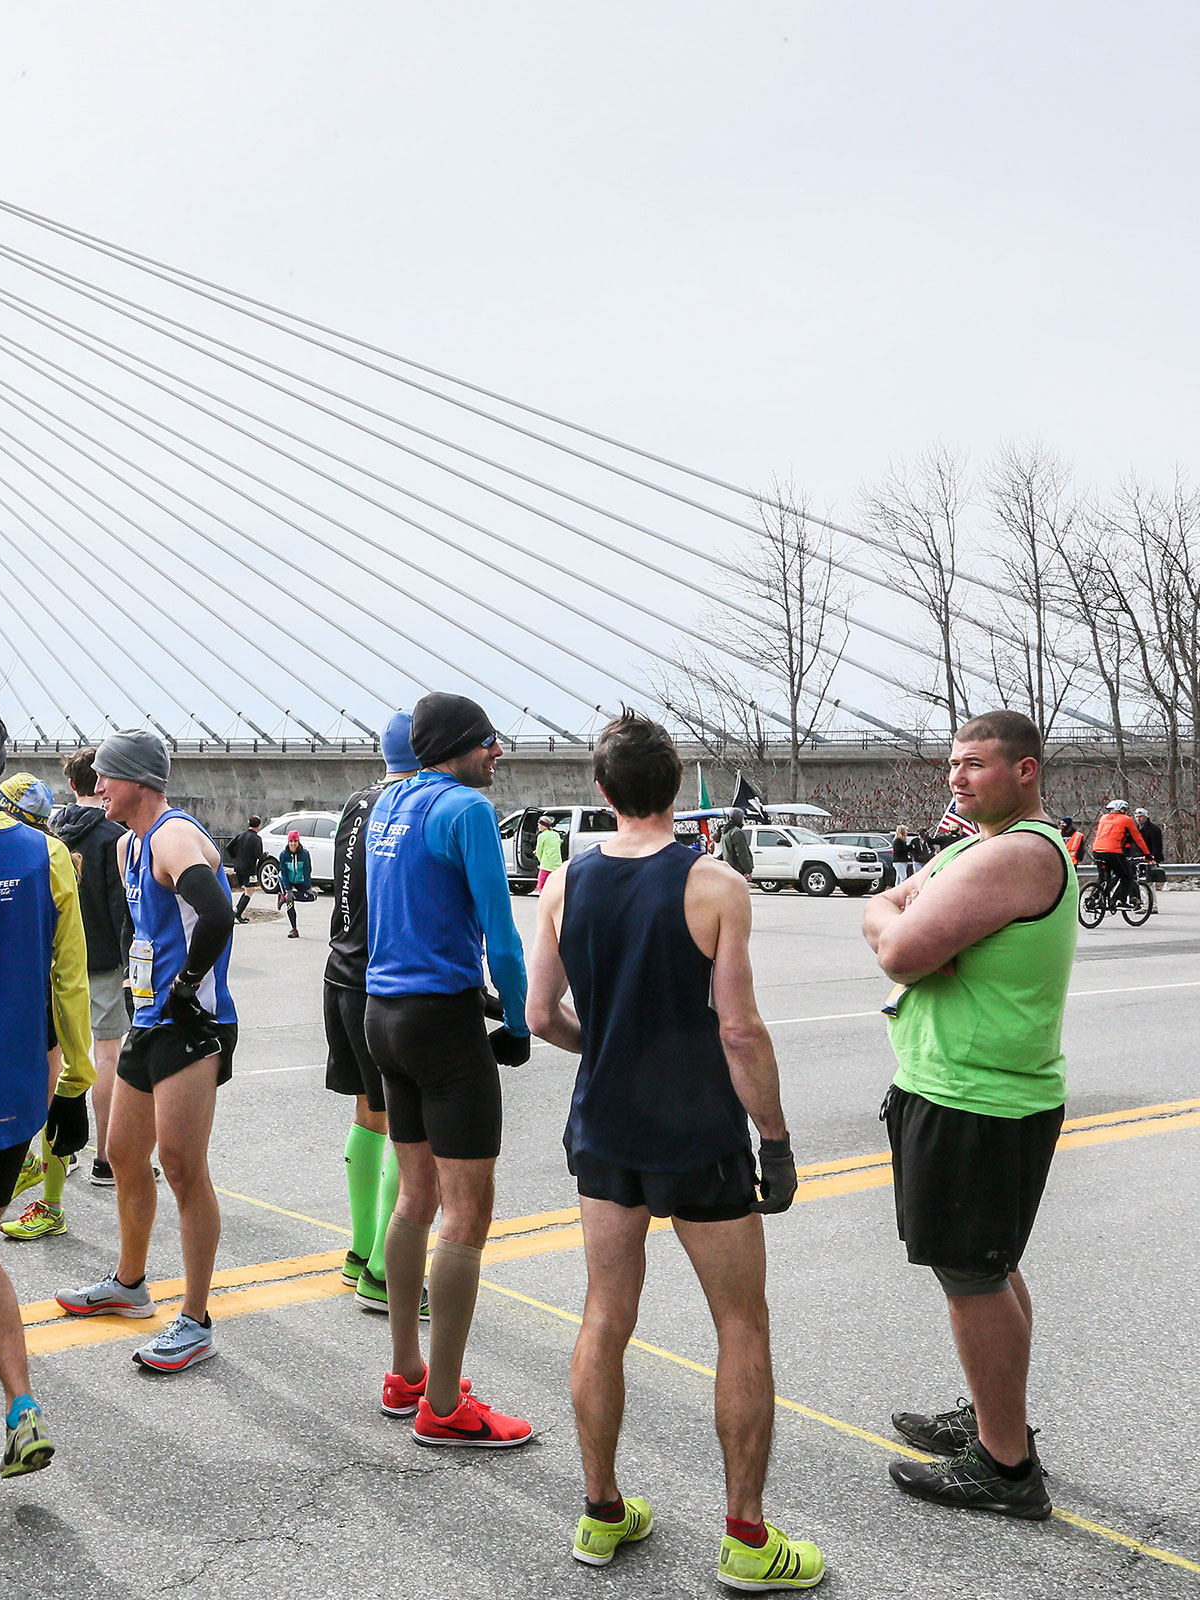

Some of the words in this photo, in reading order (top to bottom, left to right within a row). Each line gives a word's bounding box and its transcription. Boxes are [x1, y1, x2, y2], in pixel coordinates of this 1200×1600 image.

[0, 797, 20, 813] GAP
[346, 816, 362, 860] CROW
[387, 824, 411, 836] FEET
[341, 862, 351, 933] ATHLETICS
